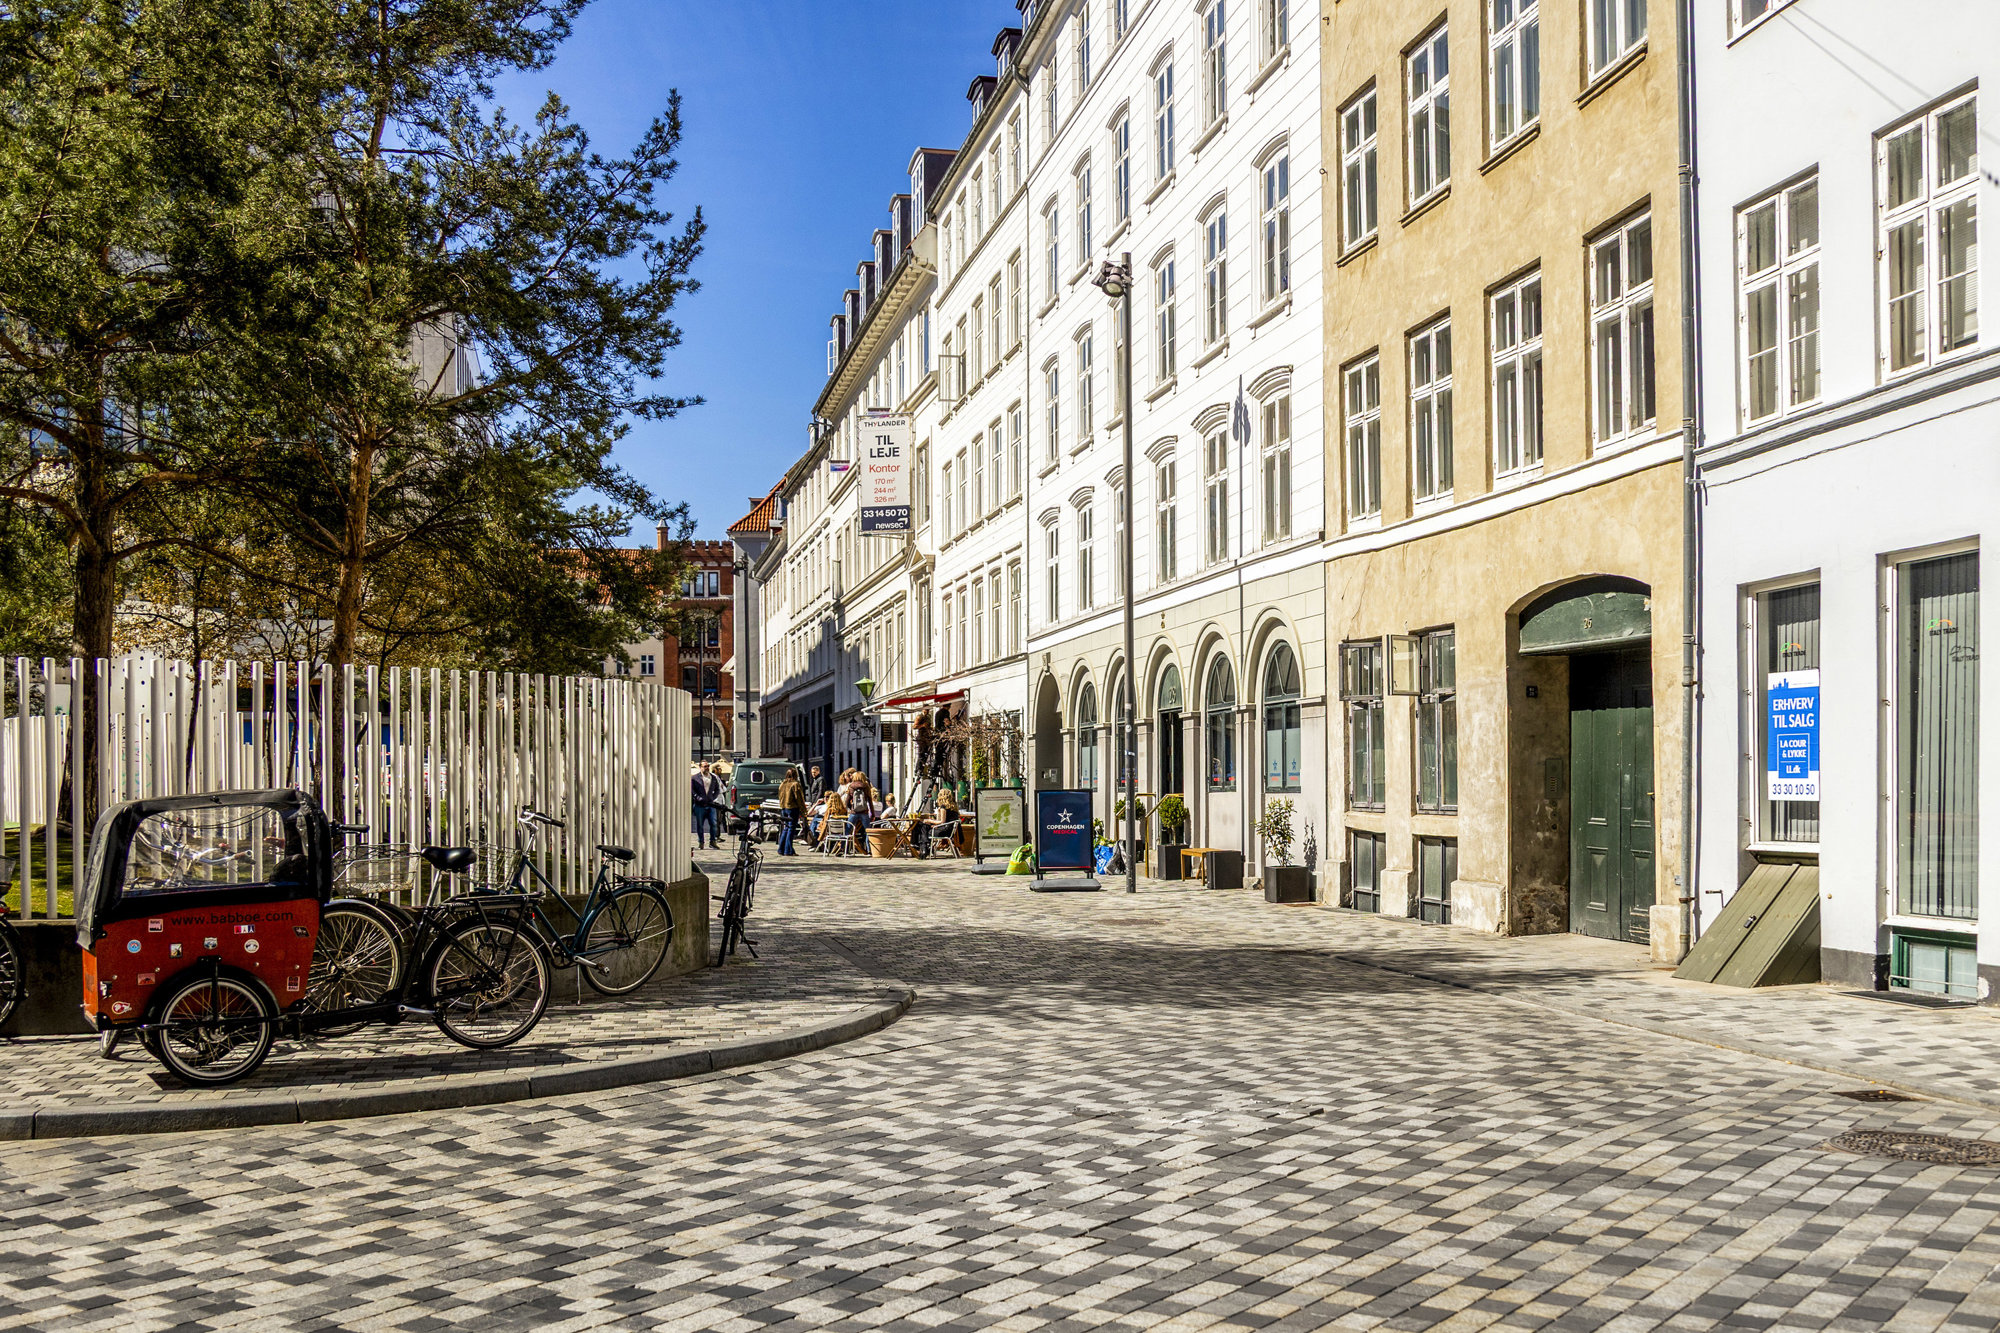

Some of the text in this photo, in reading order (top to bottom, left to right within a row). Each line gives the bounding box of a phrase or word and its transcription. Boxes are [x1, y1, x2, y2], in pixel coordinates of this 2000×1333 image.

[875, 435, 895, 446] TIL
[869, 447, 900, 459] LEJE
[869, 464, 900, 473] Kontor
[863, 508, 908, 518] 33 14 50 70
[1772, 696, 1815, 711] ERHVERV
[1772, 713, 1815, 728] TIL SALG
[1780, 739, 1807, 748] LA COUR
[1782, 749, 1807, 758] & LYKKE
[1772, 783, 1816, 795] 33 30 10 50
[171, 912, 293, 925] www.babboe.com
